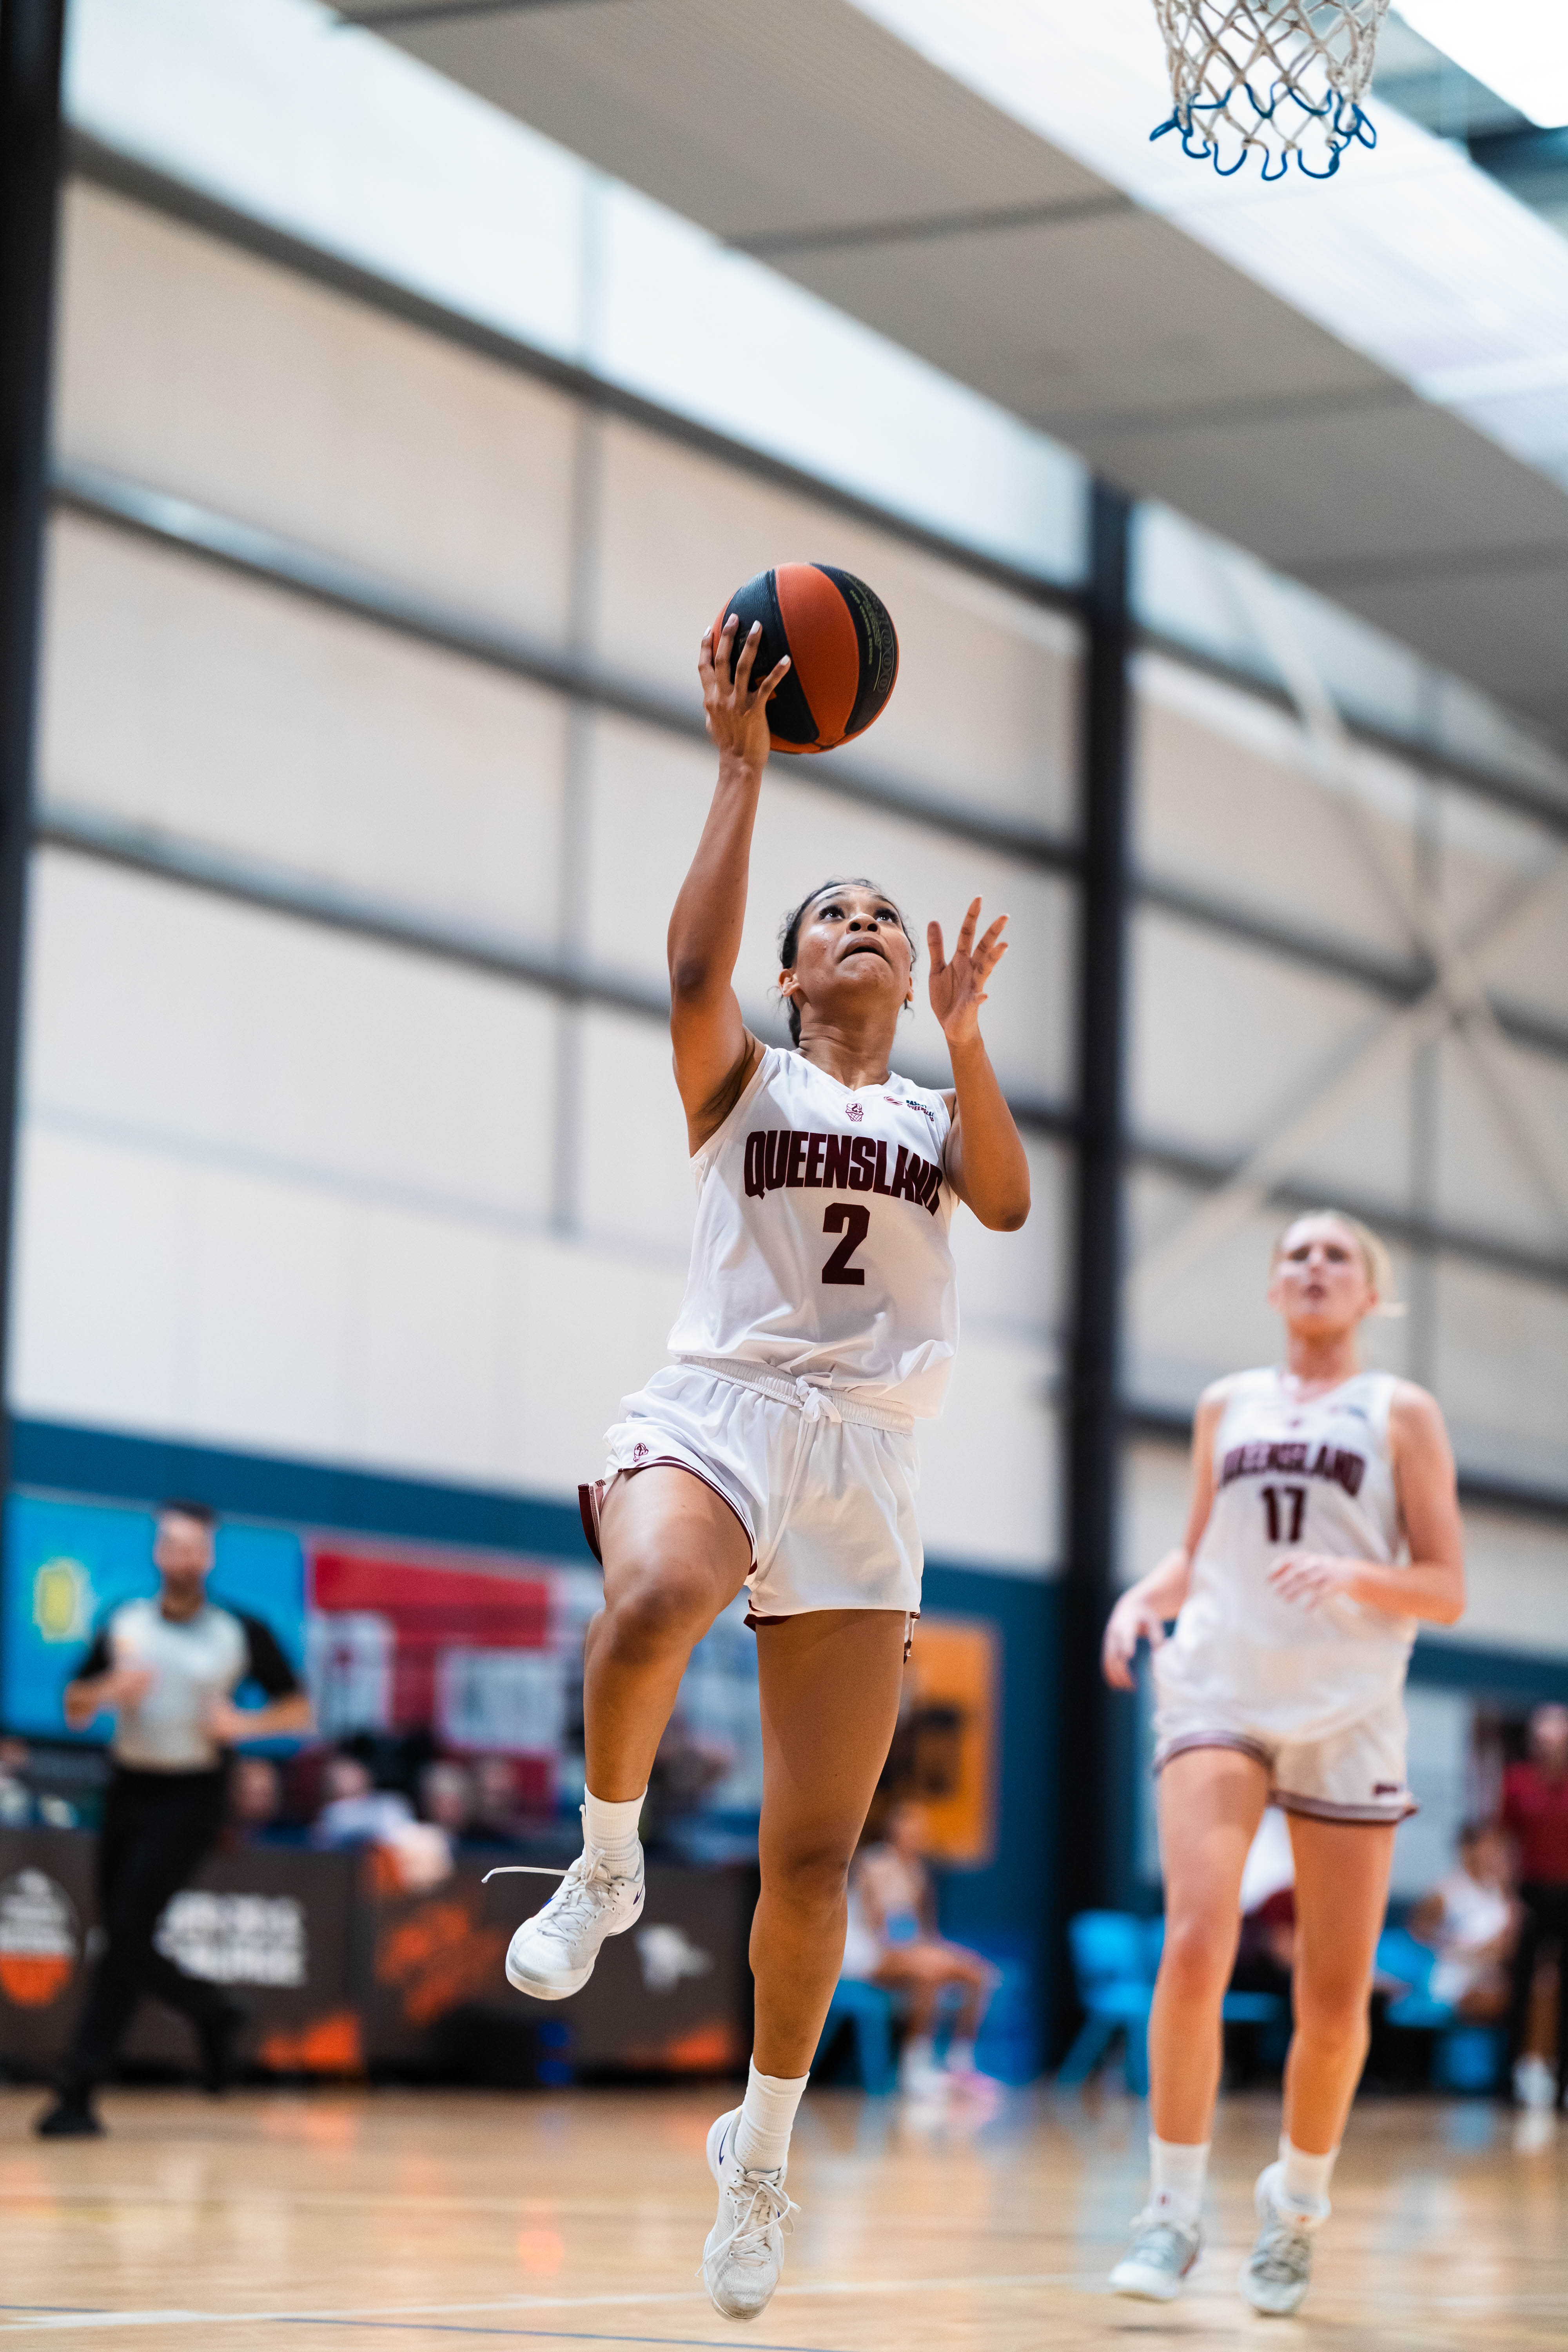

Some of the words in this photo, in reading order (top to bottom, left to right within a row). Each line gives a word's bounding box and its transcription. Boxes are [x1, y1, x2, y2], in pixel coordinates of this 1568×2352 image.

[907, 1104, 934, 1122] QUEENSLD
[744, 1130, 943, 1216] QUEENSLAND
[822, 1202, 870, 1285] 2
[1262, 1485, 1308, 1543] 17
